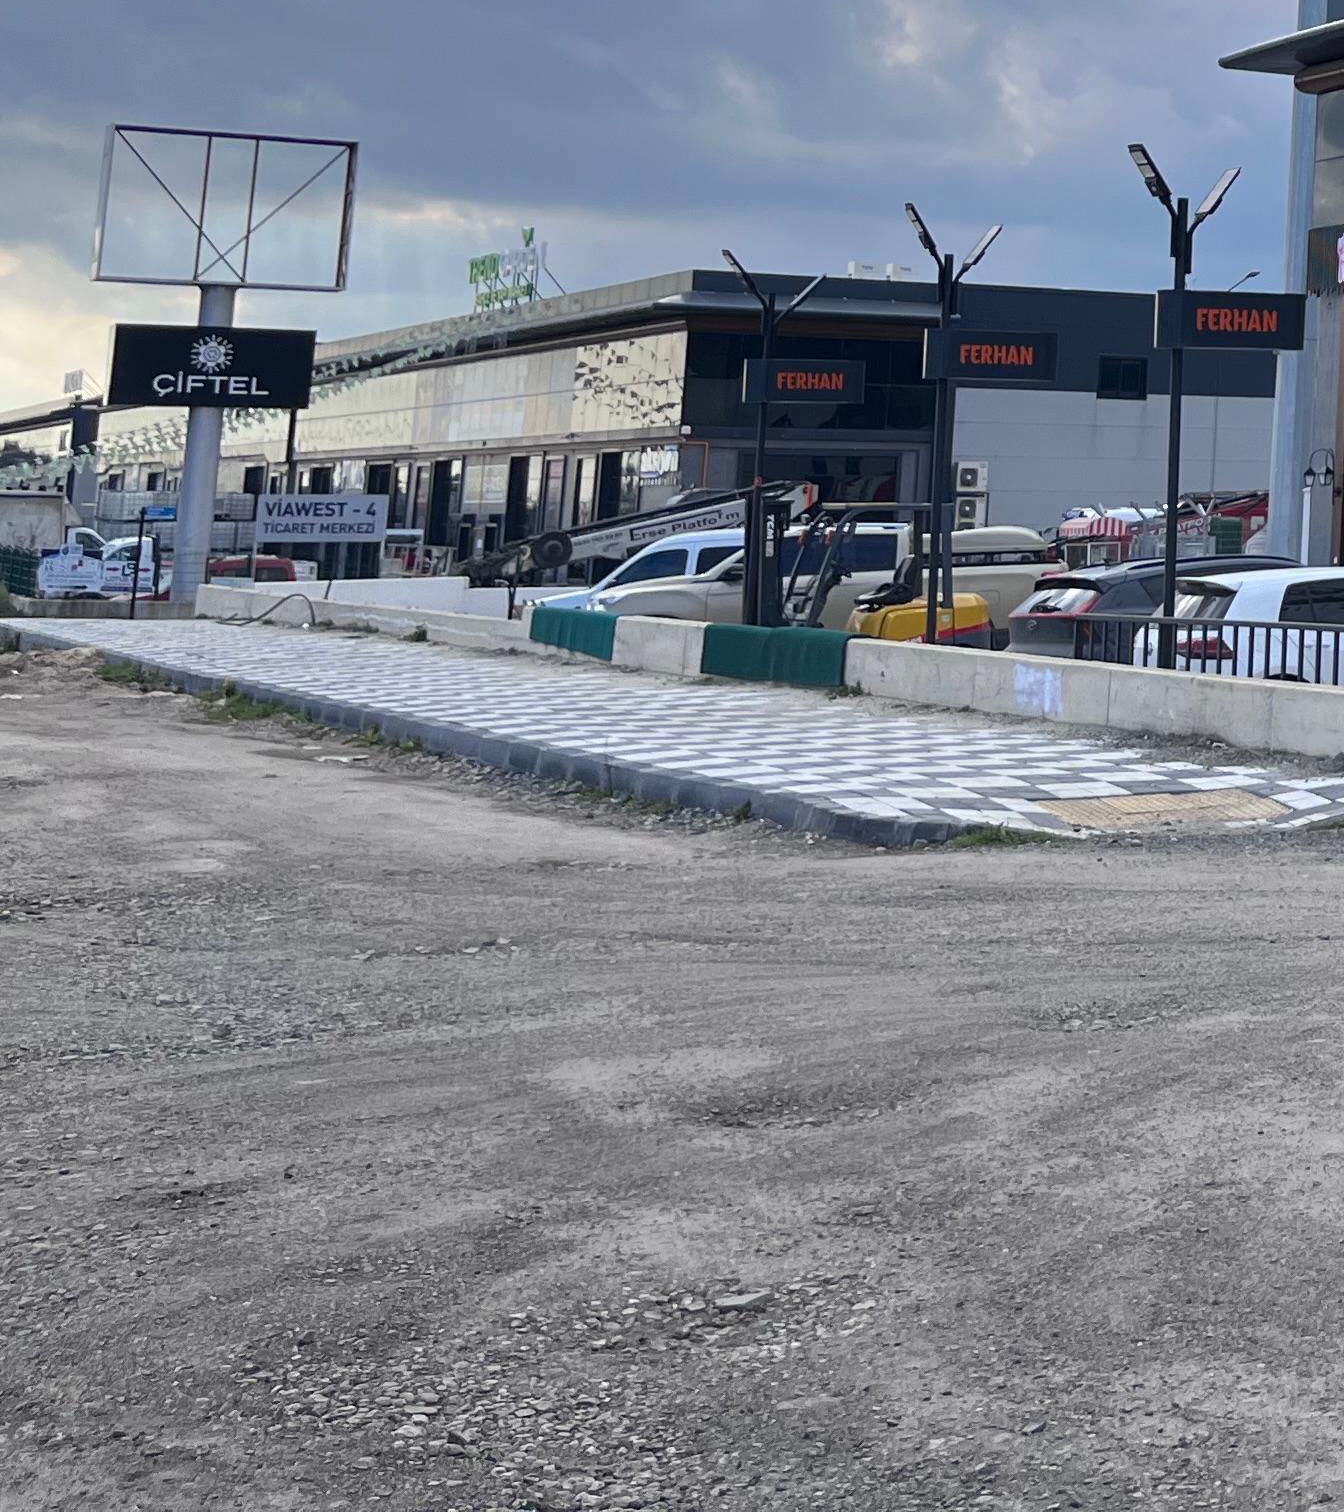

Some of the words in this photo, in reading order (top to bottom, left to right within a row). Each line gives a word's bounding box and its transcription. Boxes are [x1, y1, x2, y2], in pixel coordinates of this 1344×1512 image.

[1196, 308, 1278, 332] FERHAN
[959, 344, 1034, 366] FERHAN
[152, 370, 270, 397] ÇİFTEL
[777, 372, 844, 390] FERHAN
[265, 497, 345, 517] VİAWEST
[366, 502, 376, 517] 4
[263, 519, 315, 534] TİCARET
[319, 519, 375, 534] MERKEZİ
